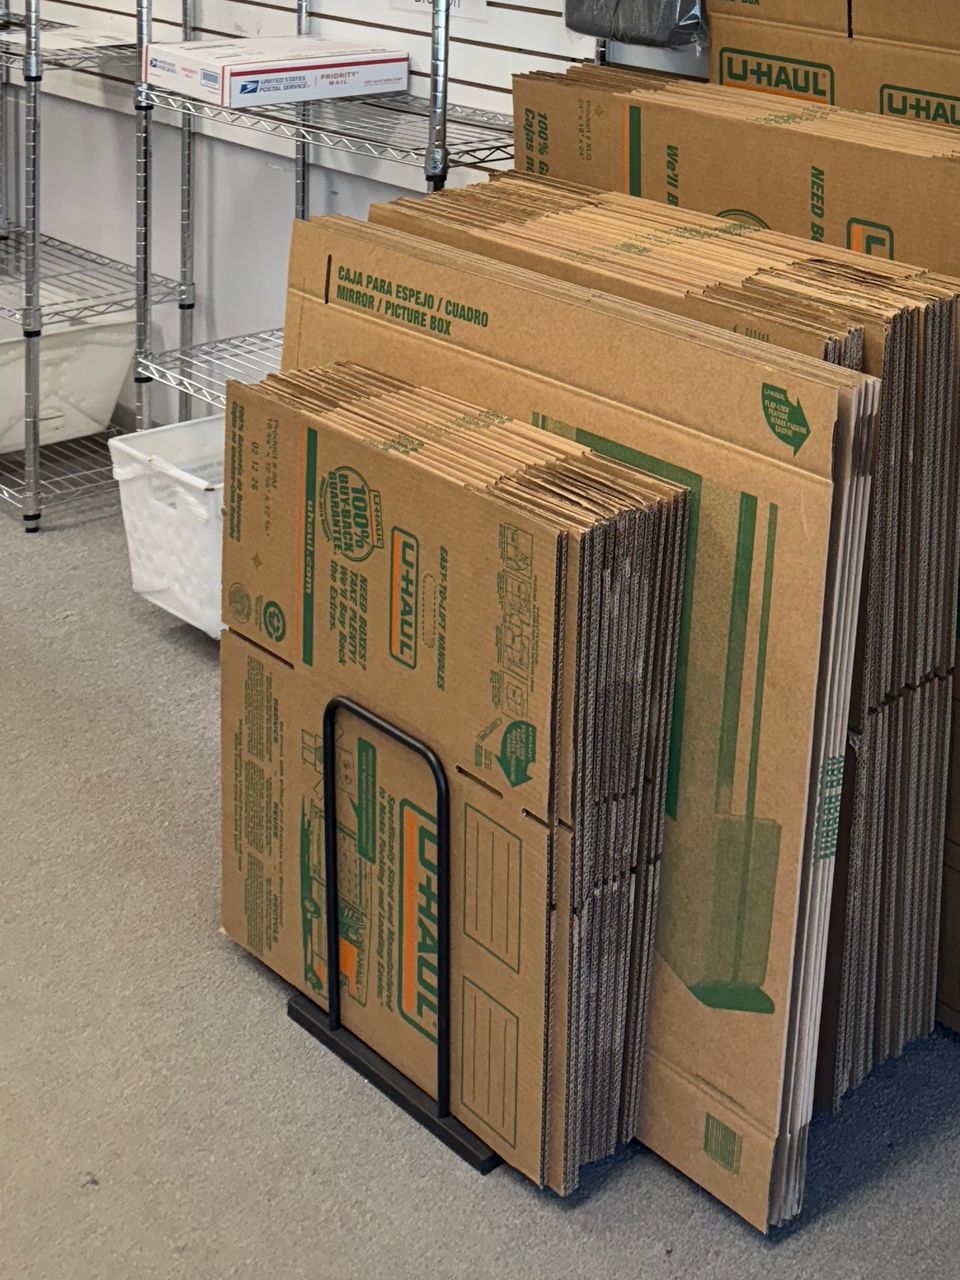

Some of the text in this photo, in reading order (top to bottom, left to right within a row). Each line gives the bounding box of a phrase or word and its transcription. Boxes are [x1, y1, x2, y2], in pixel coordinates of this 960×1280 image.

[320, 71, 359, 80] PRIORITY
[537, 112, 549, 155] 100%
[666, 144, 679, 188] We'll
[810, 166, 825, 219] NEED
[336, 284, 375, 310] MIRROR
[384, 300, 427, 328] PICTURE
[430, 315, 452, 336] BOX
[338, 266, 363, 286] CAJA
[366, 274, 393, 297] PARA
[395, 284, 434, 310] ESPEJO
[445, 300, 489, 328] CUADRO
[338, 474, 355, 554] BUY-BACK
[350, 485, 371, 549] 100%
[329, 560, 339, 631] the Extras.
[337, 565, 348, 667] We'll Buy Back
[348, 569, 358, 665] TAKE PLENTY!
[358, 574, 368, 672] NEED BOXES?
[436, 545, 448, 692] EASY-TO-LIFT HANDLES
